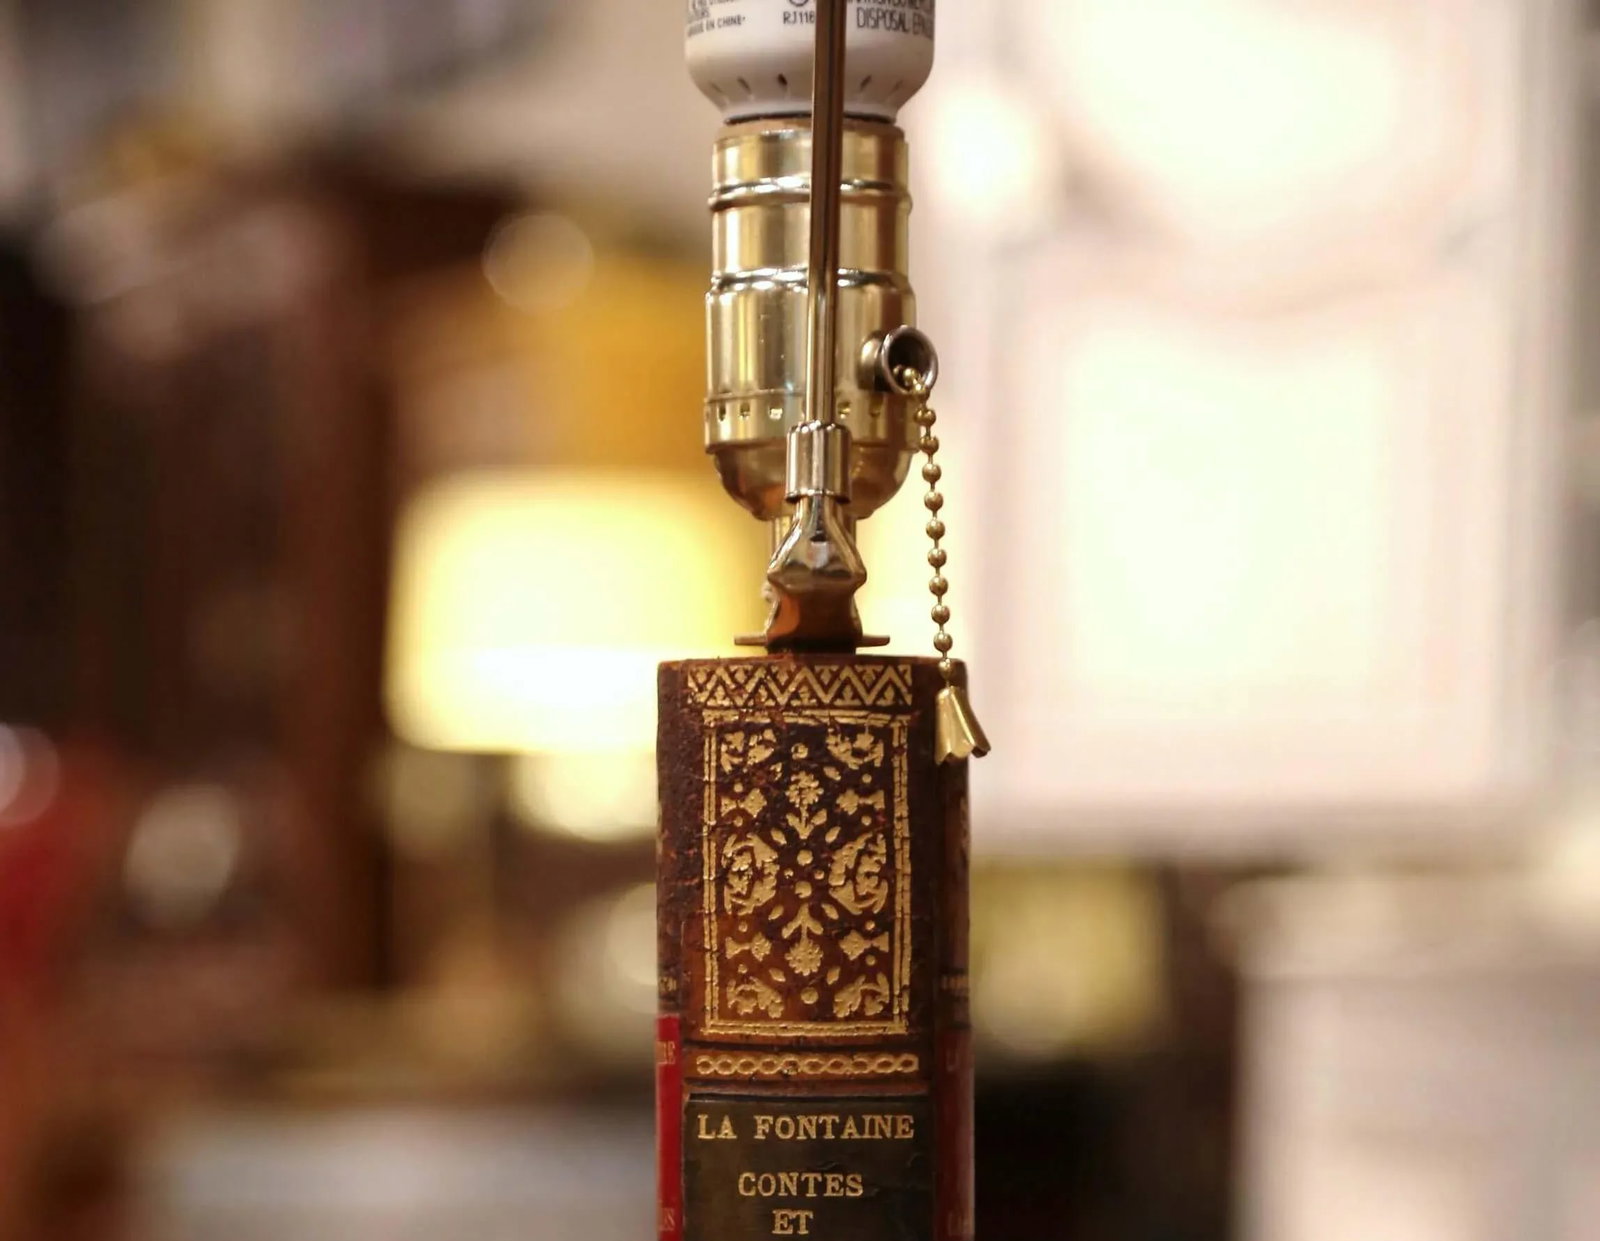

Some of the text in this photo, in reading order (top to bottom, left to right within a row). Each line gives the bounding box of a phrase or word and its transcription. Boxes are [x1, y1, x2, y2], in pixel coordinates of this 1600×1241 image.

[857, 6, 910, 33] DISPOSAL
[697, 1114, 915, 1140] LA FONTAINE
[737, 1171, 864, 1197] CONTES
[771, 1209, 813, 1235] ET
